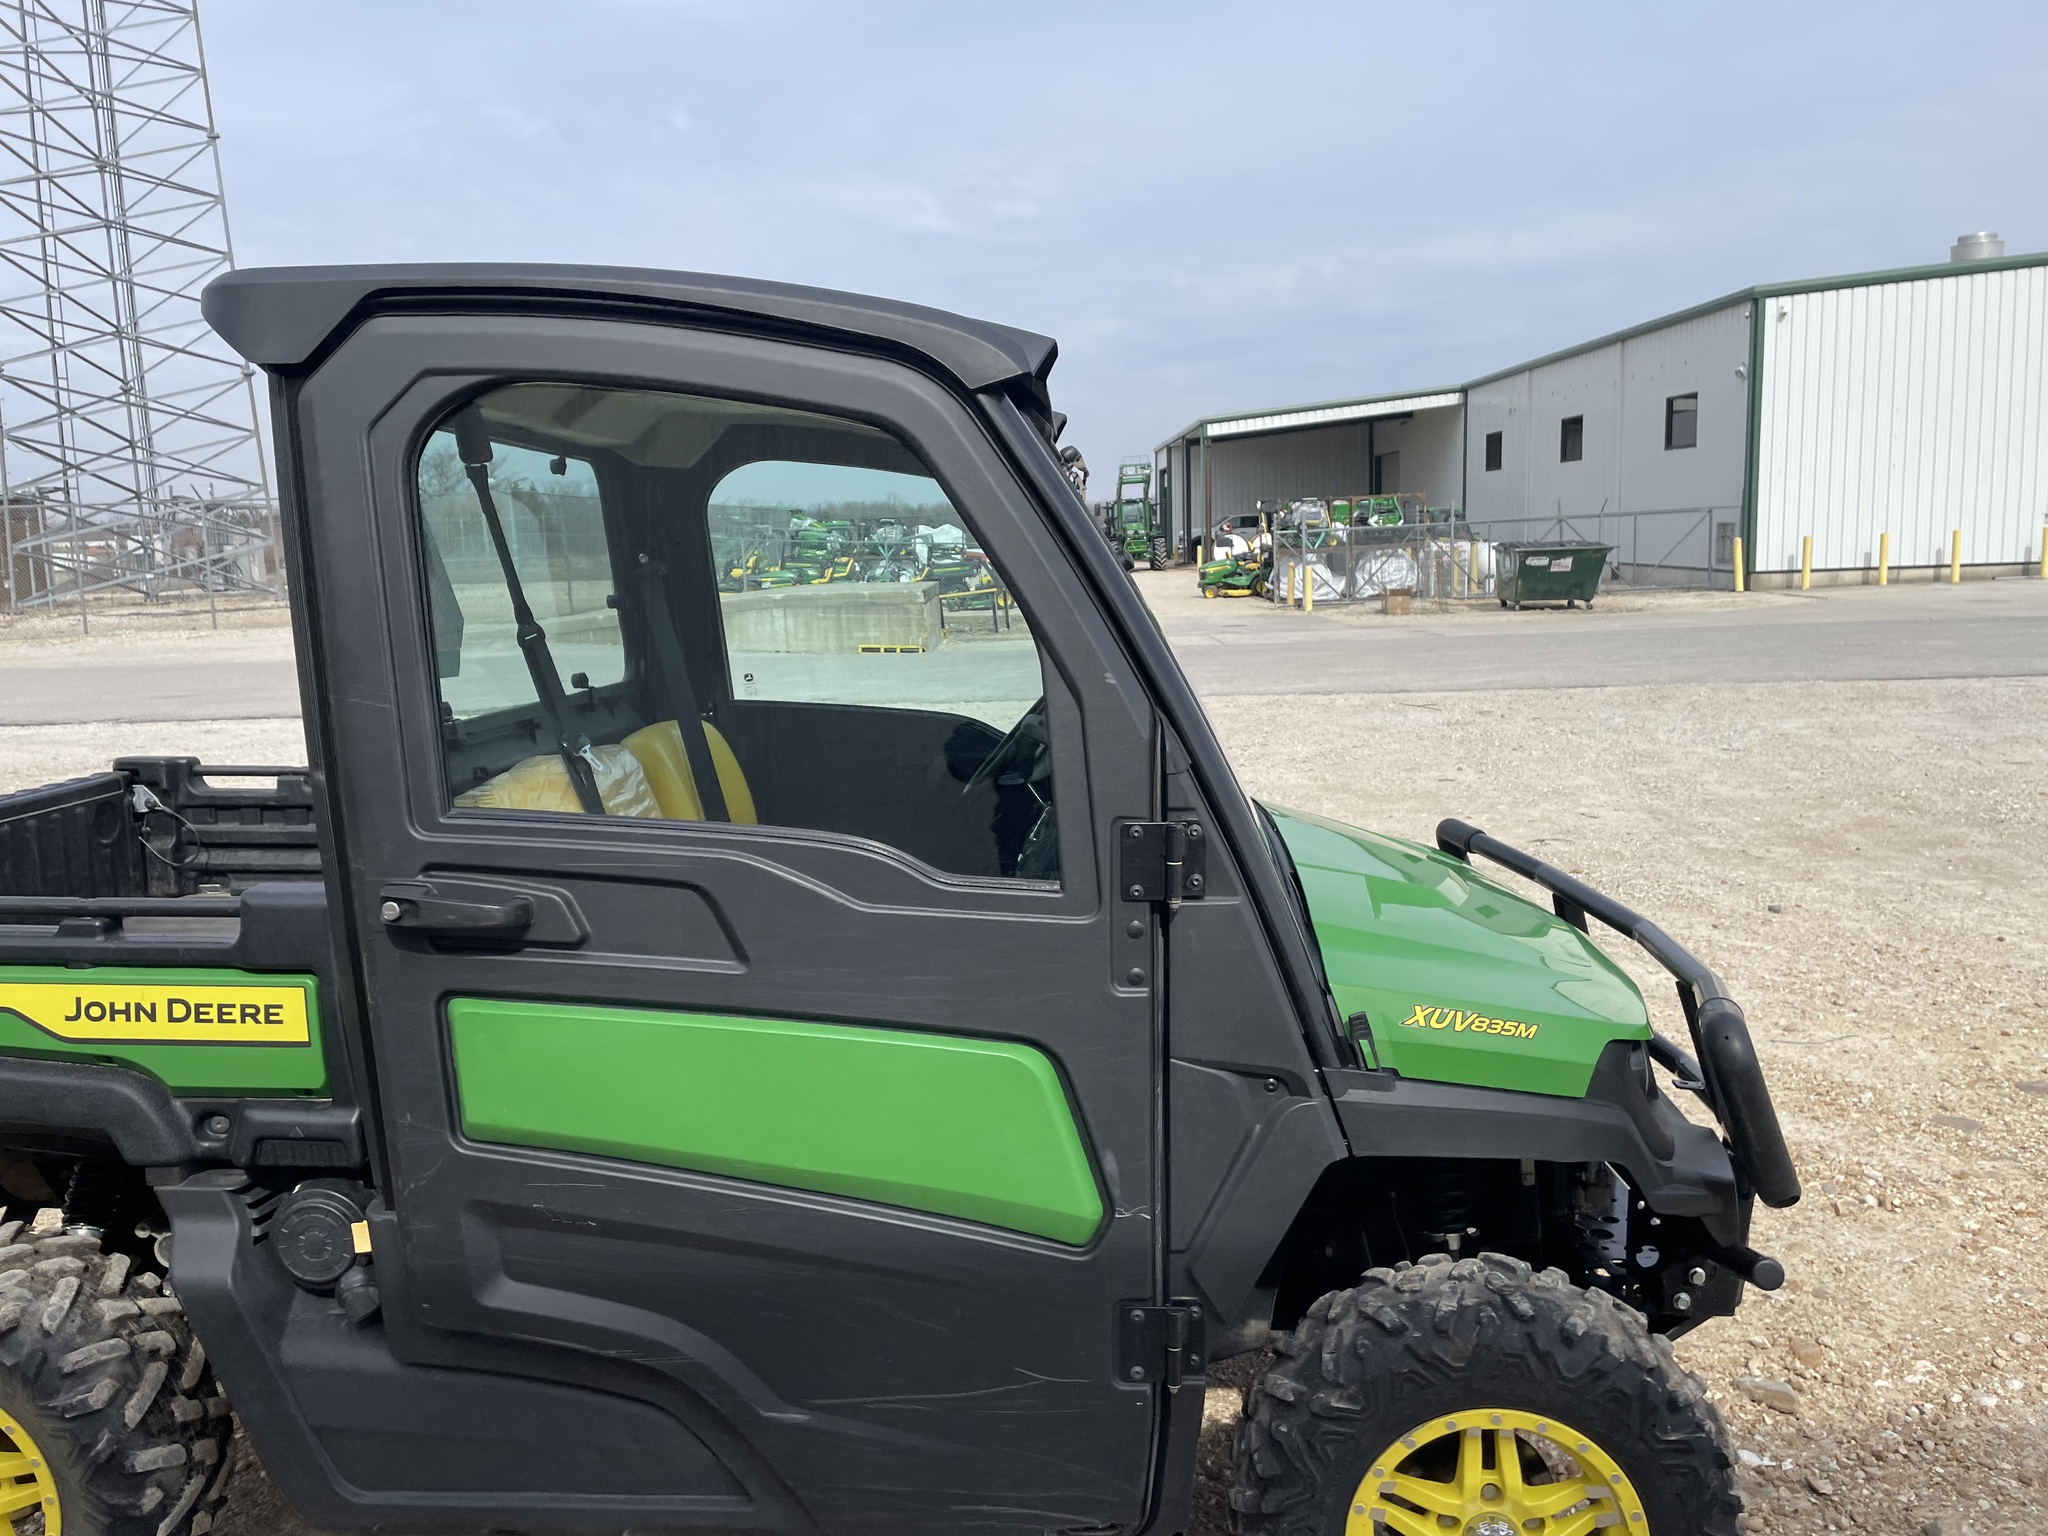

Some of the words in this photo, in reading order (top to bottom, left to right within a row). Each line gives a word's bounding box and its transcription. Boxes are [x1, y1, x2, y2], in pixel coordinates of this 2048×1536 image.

[64, 997, 157, 1022] JOHN
[167, 998, 284, 1025] DEERE
[1401, 1004, 1539, 1039] XUV835M
